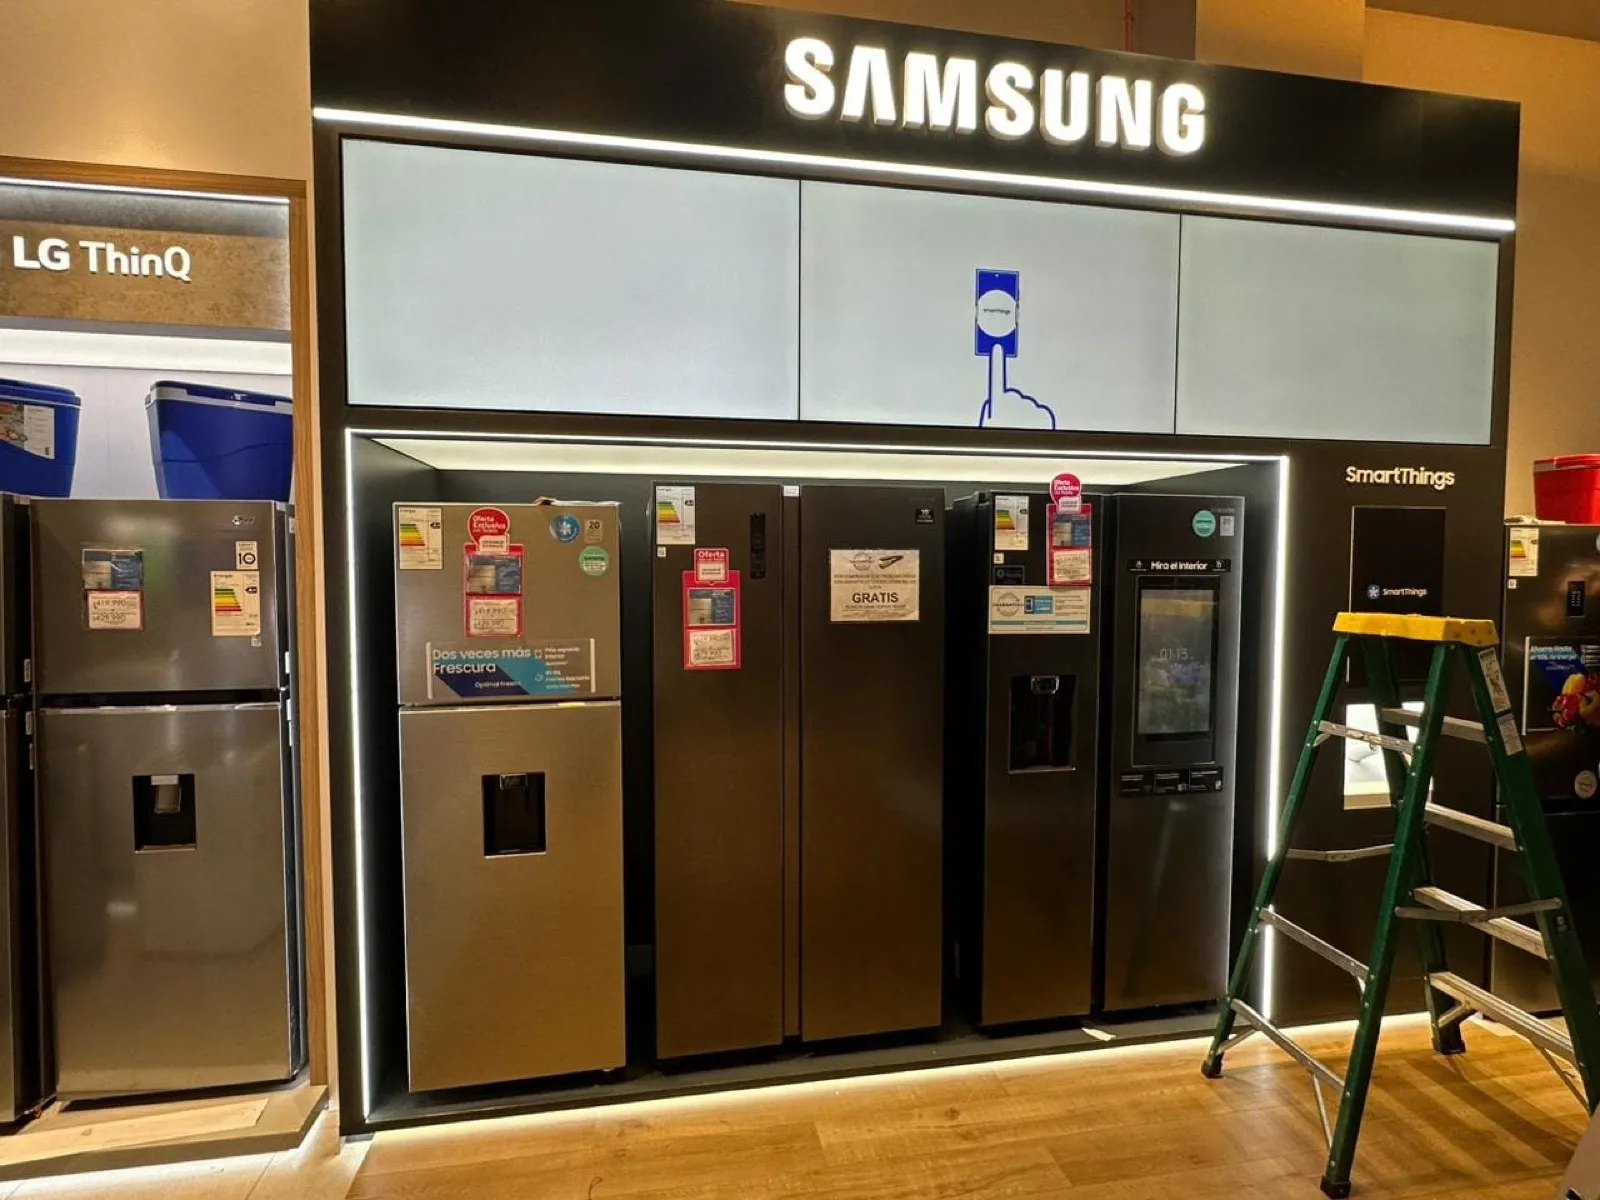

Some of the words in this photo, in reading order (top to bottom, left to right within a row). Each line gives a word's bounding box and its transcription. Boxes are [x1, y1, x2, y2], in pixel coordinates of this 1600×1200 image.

[783, 36, 1206, 156] SAMSUNG
[13, 235, 70, 271] LG
[79, 240, 192, 283] ThinQ
[1345, 466, 1455, 491] SmartThings
[698, 550, 725, 558] Oferta
[1150, 559, 1170, 570] Mira
[852, 592, 899, 603] GRATIS
[1382, 587, 1427, 597] SmartThings
[433, 649, 457, 661] Dos
[460, 649, 500, 660] veces
[501, 646, 531, 660] más
[433, 661, 497, 675] Frescura
